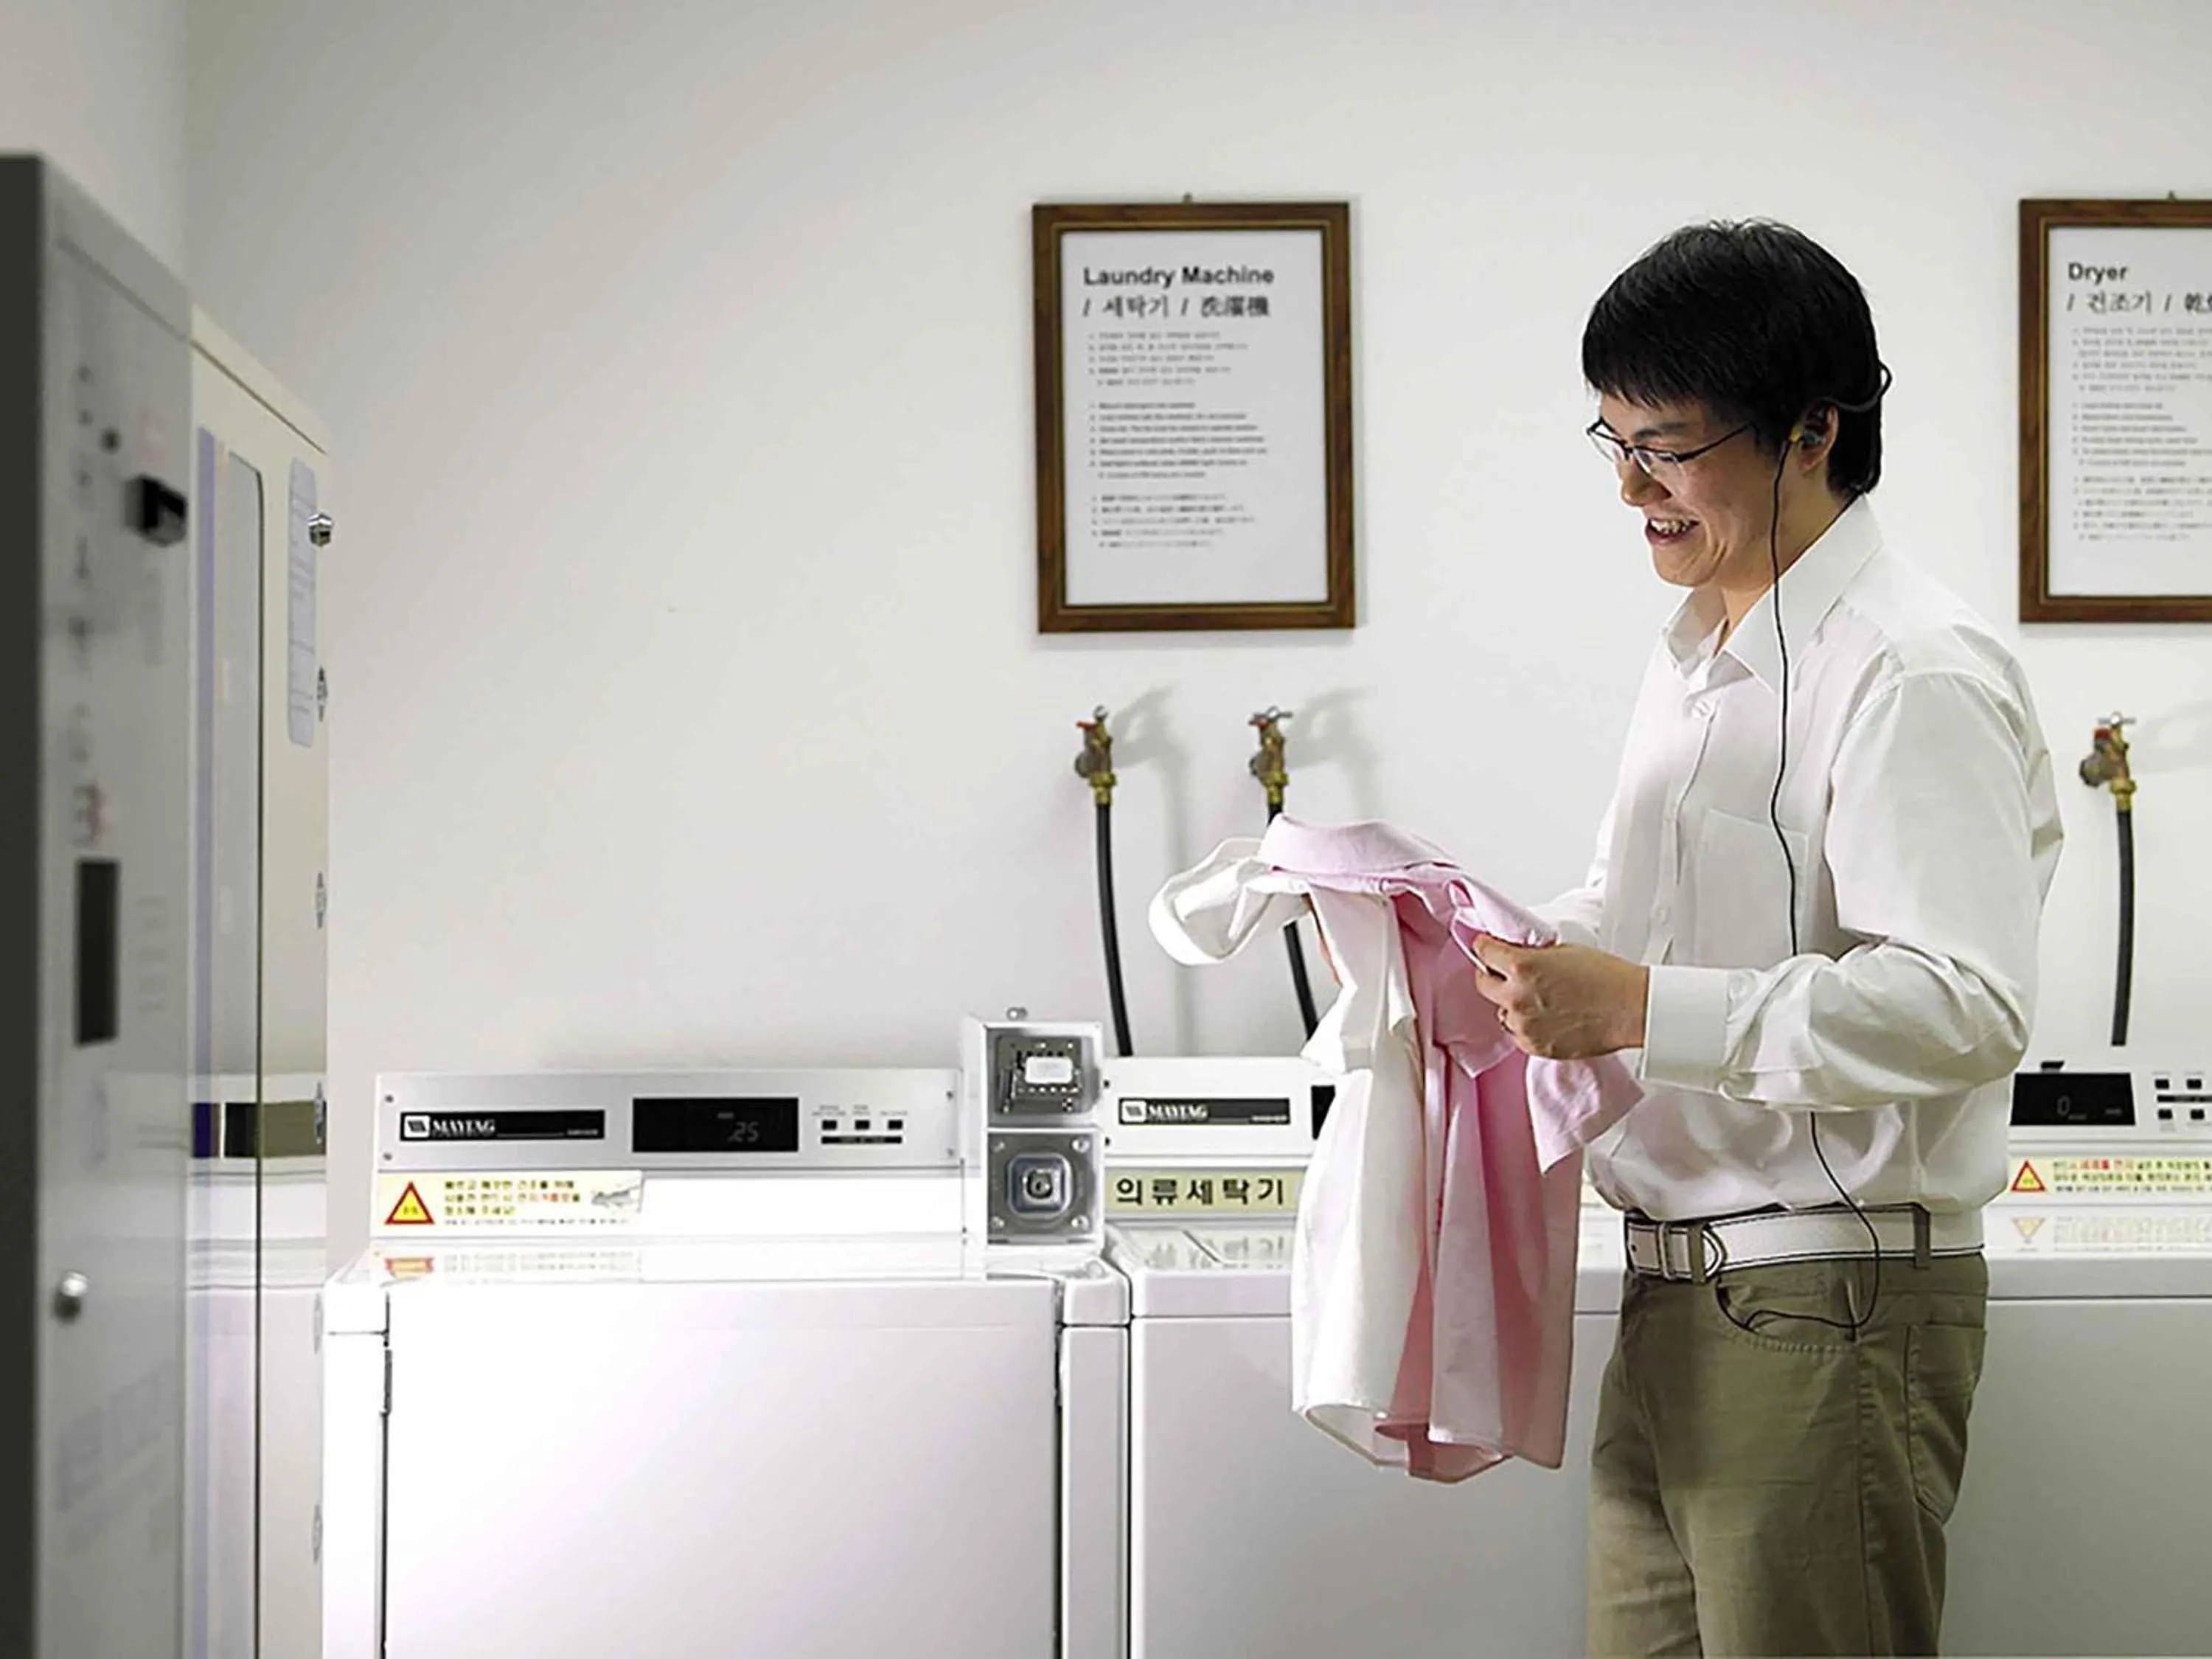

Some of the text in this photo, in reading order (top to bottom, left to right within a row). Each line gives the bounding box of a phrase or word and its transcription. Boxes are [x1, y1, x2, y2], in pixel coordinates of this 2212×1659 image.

[1083, 265, 1274, 288] Laundry Machine
[2067, 262, 2129, 285] Dryer
[1102, 296, 1169, 319] 세탁기
[2087, 290, 2152, 315] 건조기
[1116, 1178, 1284, 1206] 의류세탁기
